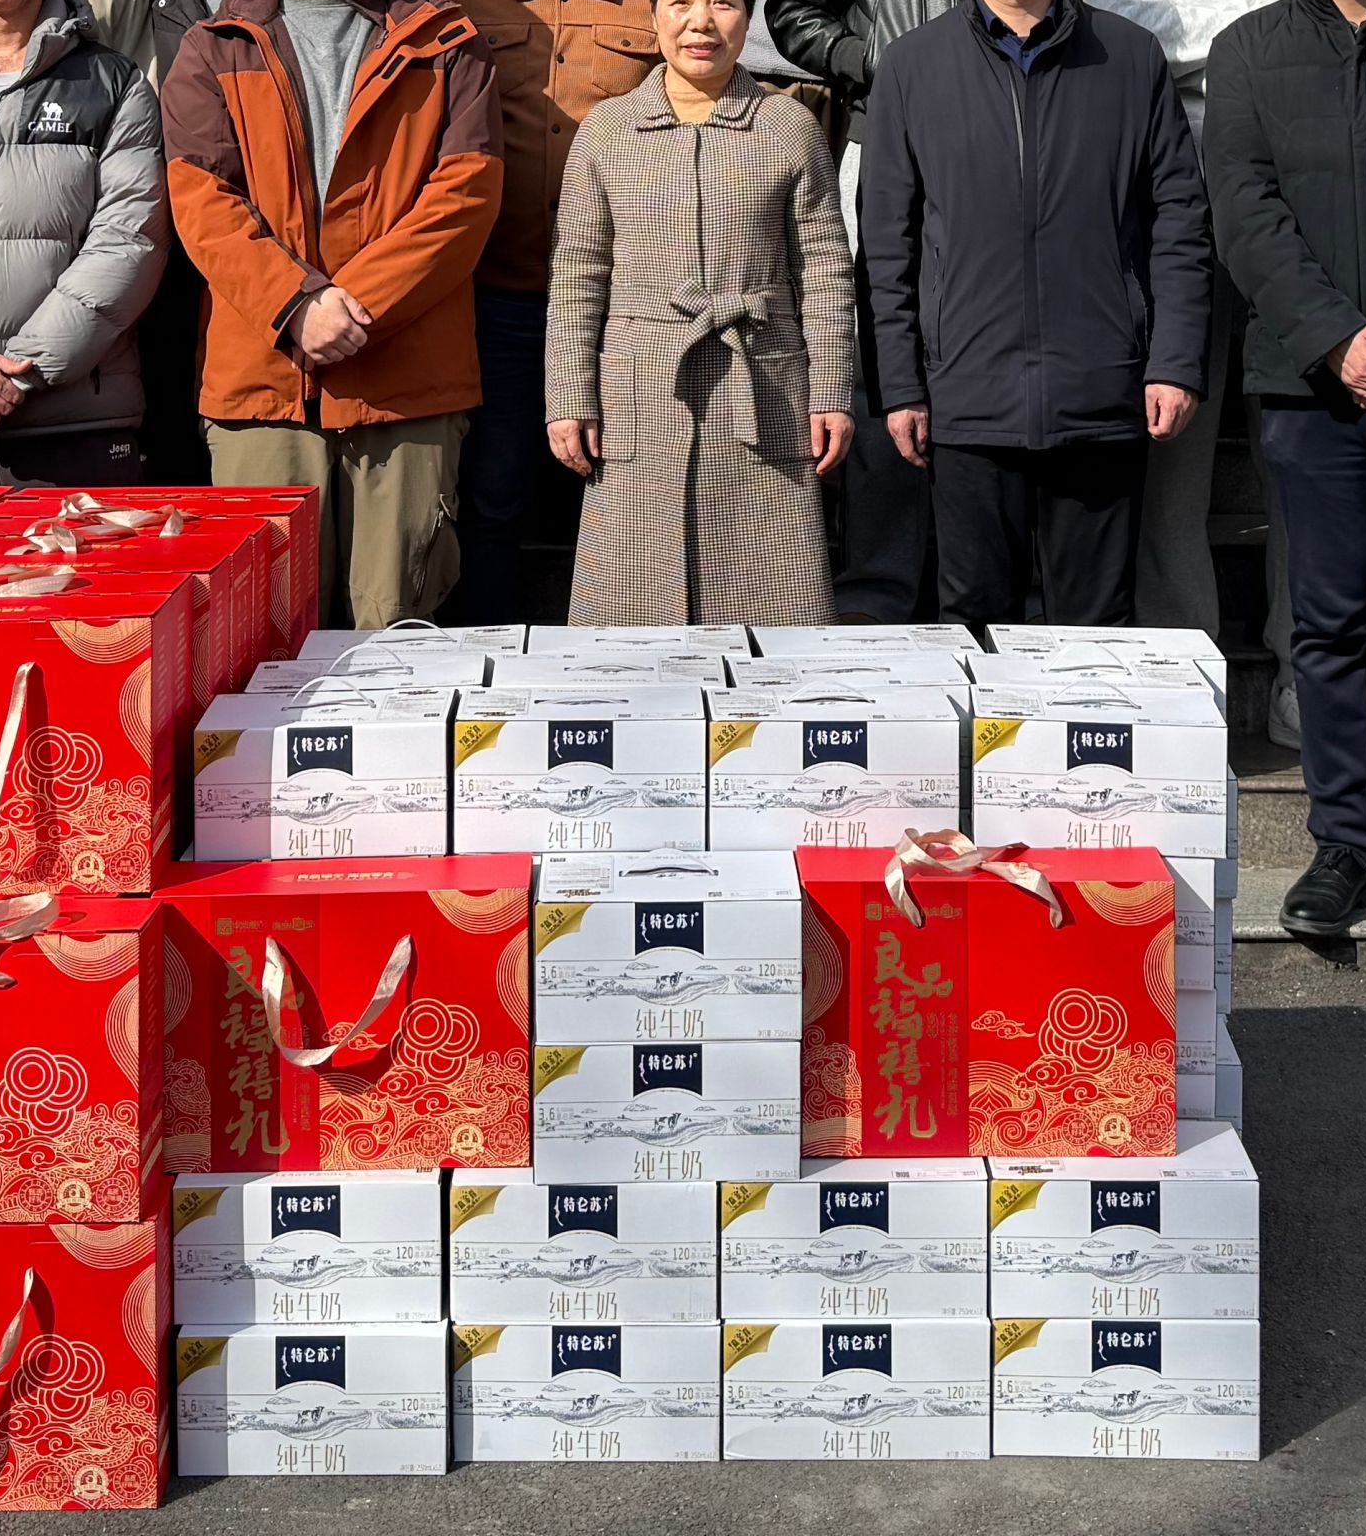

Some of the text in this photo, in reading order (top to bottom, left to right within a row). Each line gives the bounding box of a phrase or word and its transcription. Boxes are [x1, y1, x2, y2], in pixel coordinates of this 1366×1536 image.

[28, 120, 73, 133] CAMEL
[301, 736, 338, 752] 特仑苏
[562, 730, 598, 745] 特仑苏
[816, 730, 852, 745] 特仑苏
[1081, 732, 1117, 747] 特仑苏
[458, 779, 473, 792] 3.6
[664, 778, 680, 790] 120
[714, 778, 729, 790] 3.6
[919, 779, 935, 790] 120
[977, 775, 992, 788] 3.6
[198, 788, 213, 801] 3.6
[405, 783, 421, 795] 120
[1185, 784, 1201, 797] 120
[547, 820, 612, 849] 纯牛奶
[803, 819, 867, 847] 纯牛奶
[1066, 821, 1132, 848] 纯牛奶
[288, 826, 353, 856] 纯牛奶
[649, 912, 688, 928] 特仑苏
[541, 965, 557, 978] 3.6
[758, 963, 775, 976] 120
[635, 1008, 703, 1038] 纯牛奶
[869, 931, 953, 1140] 良品福禧礼
[648, 1054, 686, 1070] 特仑苏
[538, 1107, 554, 1121] 3.6
[757, 1104, 774, 1116] 120
[633, 1149, 702, 1180] 纯牛奶
[286, 1196, 325, 1212] 特仑苏
[563, 1196, 602, 1211] 特仑苏
[834, 1192, 873, 1207] 特仑苏
[1105, 1191, 1144, 1206] 特仑苏
[396, 1246, 413, 1259] 120
[454, 1247, 470, 1260] 3.6
[672, 1248, 690, 1260] 120
[725, 1242, 741, 1255] 3.6
[943, 1243, 961, 1255] 120
[996, 1241, 1012, 1254] 3.6
[1215, 1243, 1232, 1255] 120
[177, 1249, 193, 1262] 3.6
[272, 1290, 341, 1321] 纯牛奶
[549, 1290, 617, 1319] 纯牛奶
[819, 1286, 888, 1316] 纯牛奶
[1091, 1286, 1160, 1316] 纯牛奶
[566, 1336, 605, 1350] 特仑苏
[837, 1335, 876, 1350] 特仑苏
[1106, 1331, 1145, 1347] 特仑苏
[290, 1346, 329, 1362] 特仑苏
[676, 1387, 693, 1399] 120
[728, 1386, 744, 1398] 3.6
[946, 1386, 964, 1398] 120
[996, 1379, 1012, 1393] 3.6
[1217, 1384, 1234, 1397] 120
[180, 1399, 196, 1412] 3.6
[401, 1398, 418, 1411] 120
[551, 1430, 621, 1459] 纯牛奶
[823, 1429, 891, 1458] 纯牛奶
[1092, 1426, 1161, 1456] 纯牛奶
[276, 1443, 346, 1473] 纯牛奶
